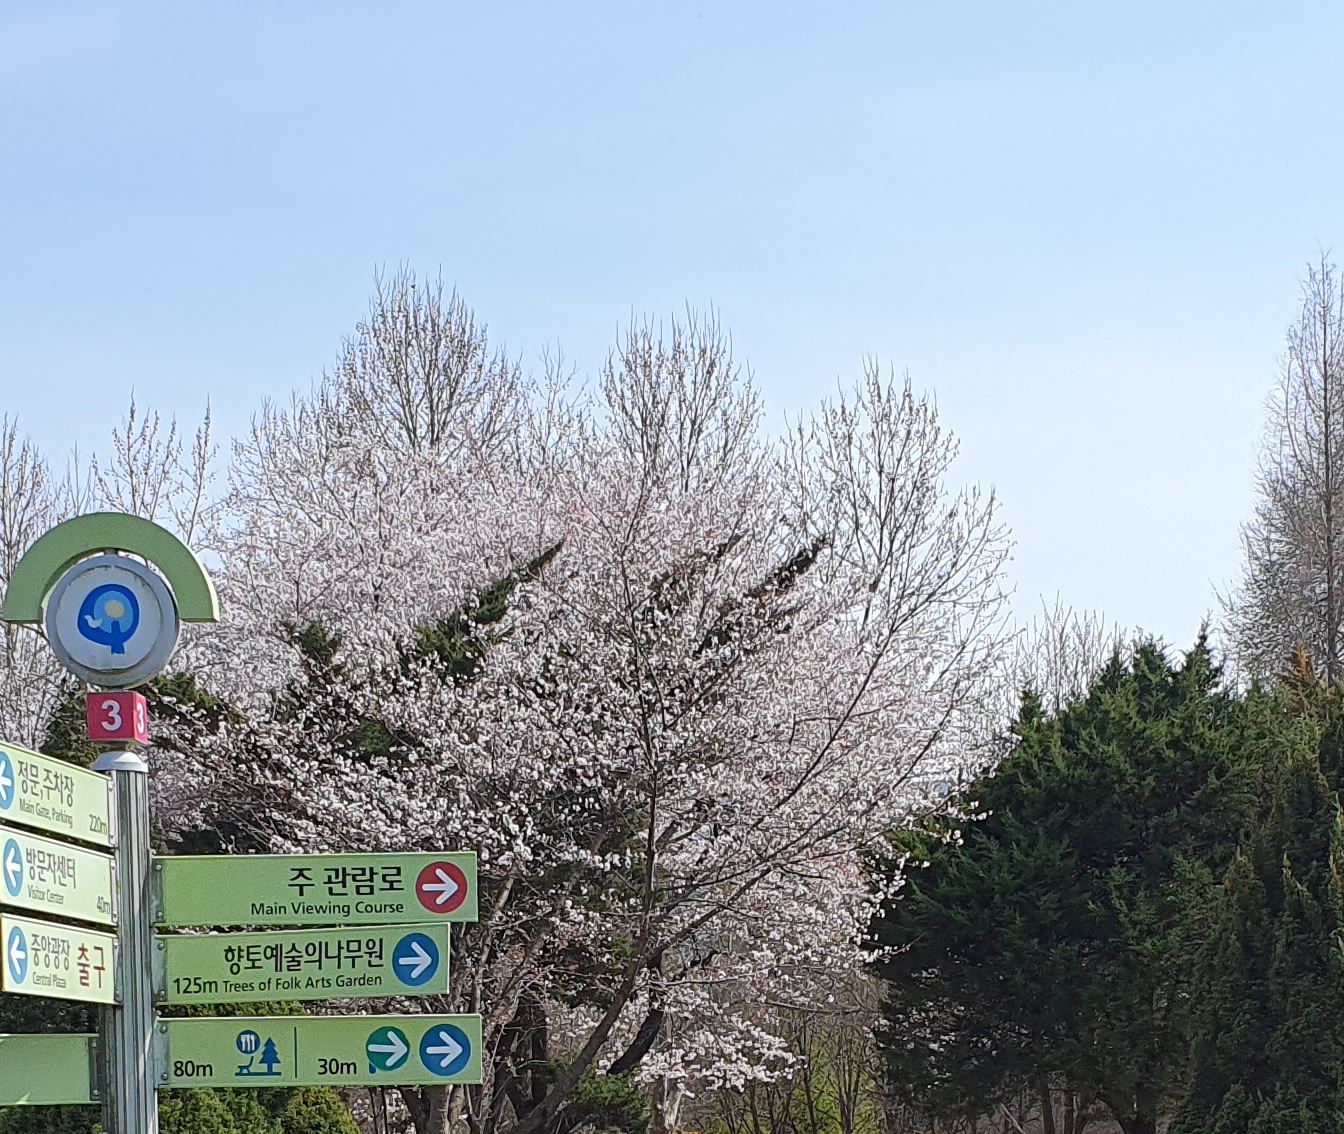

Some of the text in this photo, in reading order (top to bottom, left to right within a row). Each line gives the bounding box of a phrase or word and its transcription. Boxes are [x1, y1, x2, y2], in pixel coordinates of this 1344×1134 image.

[101, 699, 122, 731] 3
[136, 702, 145, 734] 3
[19, 797, 35, 815] Main
[51, 806, 74, 830] Parking
[25, 846, 77, 890] 방문자센터
[287, 865, 405, 897] 주 관람로
[27, 884, 65, 905] Visitor Center
[250, 901, 405, 917] Main Viewing Course
[30, 933, 106, 989] 중앙광장 출구
[223, 937, 385, 976] 향토예술의나무원
[32, 971, 52, 987] Central
[173, 973, 383, 995] 125m Trees of Folk Arts Garden
[173, 1060, 214, 1077] 80m
[317, 1058, 358, 1075] 30m
